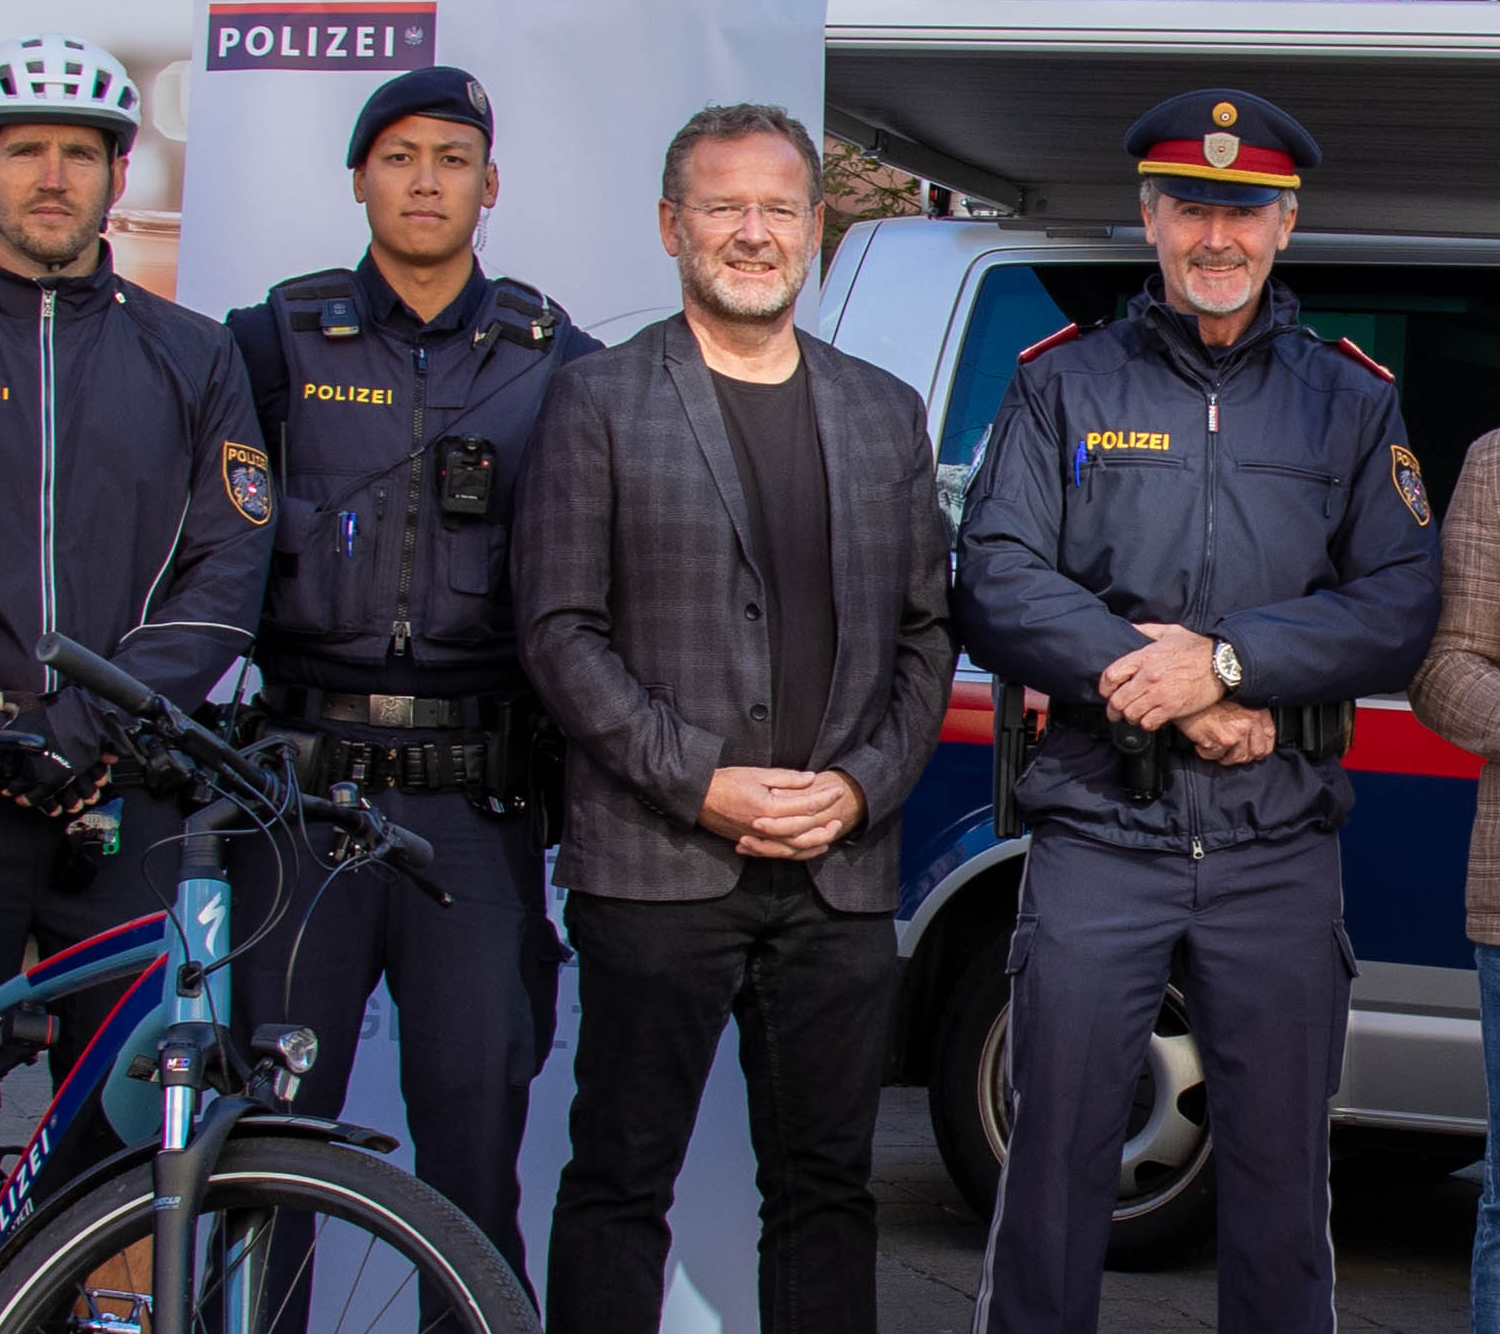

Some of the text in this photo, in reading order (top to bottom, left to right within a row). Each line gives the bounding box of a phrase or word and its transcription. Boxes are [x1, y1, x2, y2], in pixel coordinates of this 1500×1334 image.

[218, 24, 398, 59] POLIZEI
[303, 383, 394, 405] POLIZEI
[1086, 432, 1170, 452] POLIZEI
